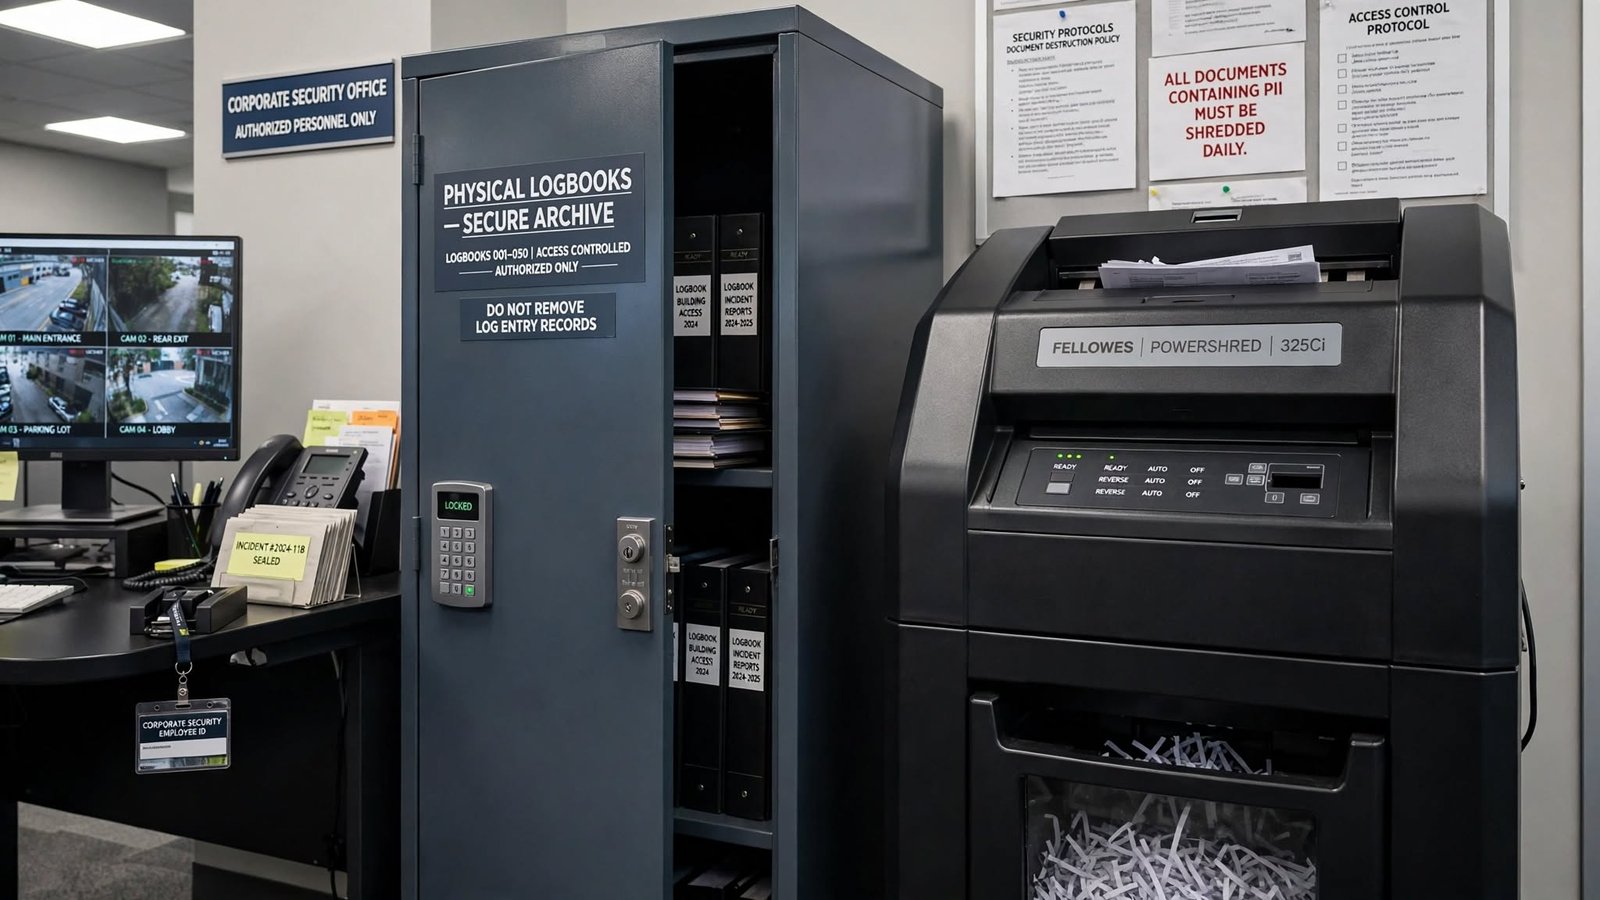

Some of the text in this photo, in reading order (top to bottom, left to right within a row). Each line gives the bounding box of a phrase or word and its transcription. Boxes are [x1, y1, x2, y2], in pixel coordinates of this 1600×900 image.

[1349, 2, 1450, 24] ACCESS CONTROL
[1013, 23, 1114, 42] SECURITY PROTOCOLS
[1367, 19, 1430, 35] PROTOCOL
[1007, 35, 1120, 54] DOCUMENT DESTRUCTION POLICY
[1164, 62, 1287, 86] ALL DOCUMENTS
[228, 79, 387, 114] CORPORATE SECURITY OFFICE
[1168, 82, 1282, 104] CONTAINING PII
[1195, 103, 1257, 120] MUST BE
[235, 110, 376, 139] AUTHORIZED PERSONNEL ONLY
[1186, 122, 1265, 140] SHREDDED
[1203, 142, 1247, 157] DAILY.
[444, 168, 632, 206] PHYSICAL LOGBOOKS
[462, 208, 529, 234] SECURE
[533, 201, 614, 229] ARCHIVE
[446, 250, 491, 264] LOGBOOKS
[536, 247, 569, 258] ACCESS
[571, 242, 631, 255] CONTROLLED
[495, 261, 579, 276] AUTHORIZED ONLY
[676, 285, 707, 293] LOGBOOK
[724, 282, 754, 291] LOGBOOK
[677, 297, 706, 305] BUILDING
[725, 296, 753, 304] INCIDENT
[487, 300, 585, 317] DO NOT REMOVE
[679, 309, 702, 317] ACCESS
[725, 307, 752, 315] REPORTS
[476, 317, 597, 334] LOG ENTRY RECORDS
[684, 320, 698, 328] 2024
[22, 334, 42, 342] MAIN
[42, 334, 81, 343] ENTRANCE
[120, 335, 135, 343] CAM
[138, 335, 147, 343] 02
[152, 335, 172, 343] REAR
[173, 335, 188, 343] EXIT
[1053, 338, 1325, 354] FELLOWES POWERSHRED 325Ci
[119, 426, 135, 434] CAM
[137, 426, 146, 434] 04
[152, 426, 176, 434] LOBBY
[445, 501, 473, 511] LOCKED
[236, 541, 269, 552] INCIDENT
[253, 555, 280, 566] SEALED
[688, 632, 717, 643] LOGBOOK
[732, 637, 761, 648] LOGBOOK
[689, 644, 716, 654] BUILDING
[733, 650, 760, 660] INCIDENT
[691, 656, 713, 666] ACCESS
[734, 661, 759, 671] REPORTS
[143, 718, 222, 729] CORPORATE SECURITY
[159, 728, 197, 737] EMPLOYEE
